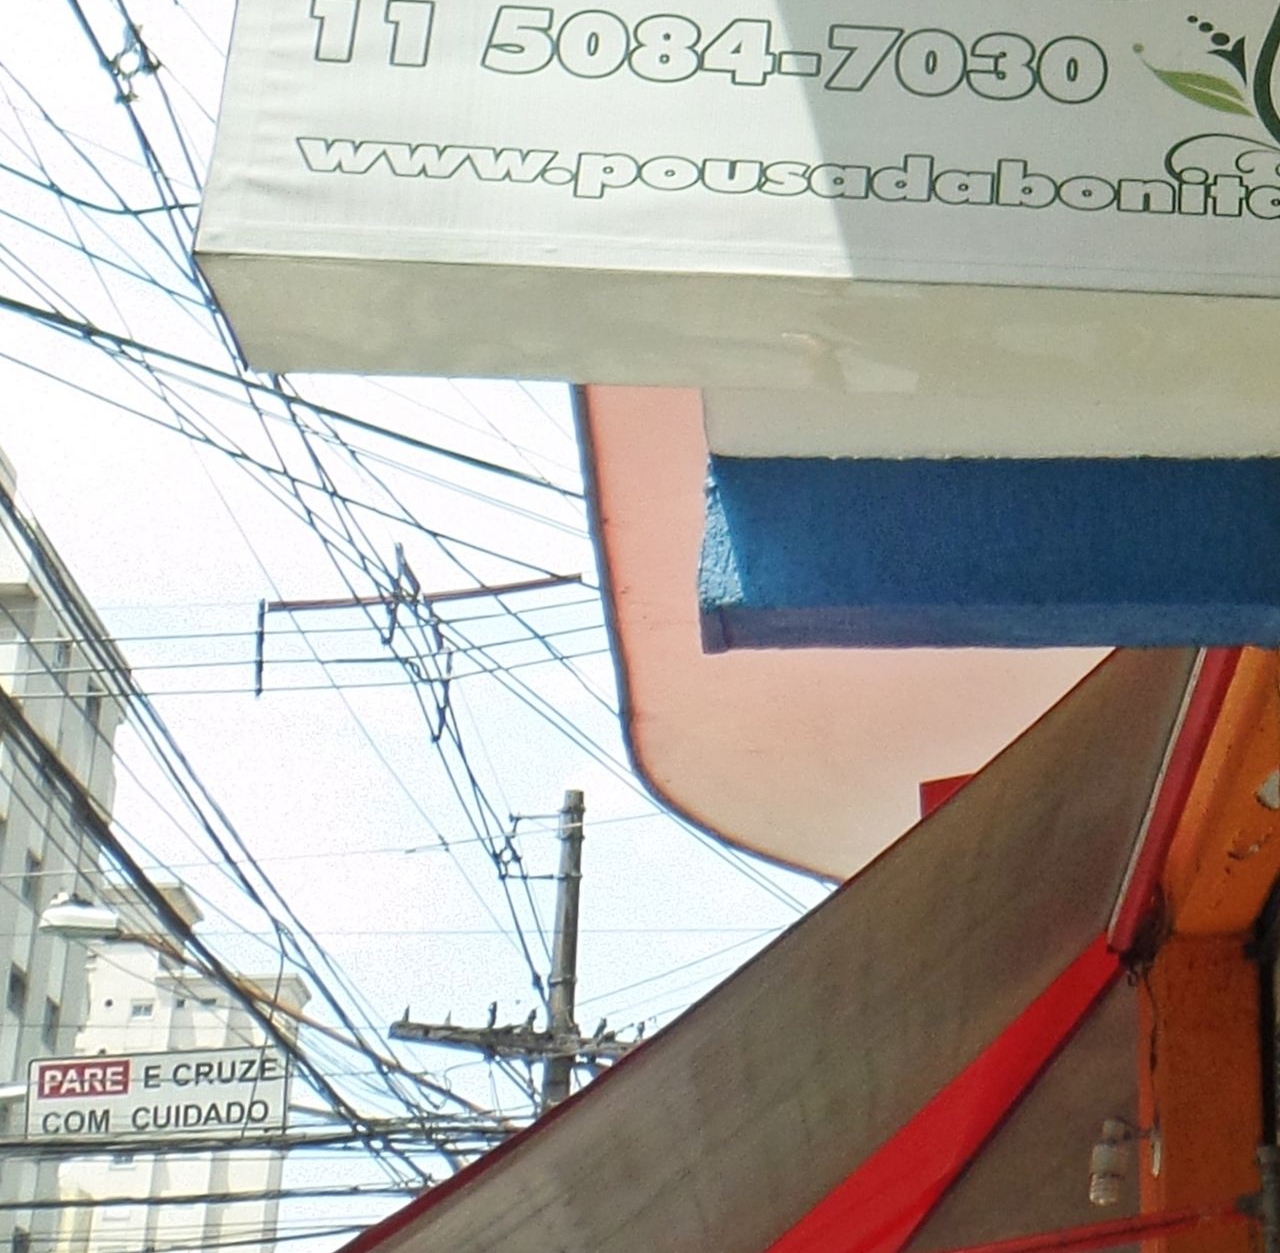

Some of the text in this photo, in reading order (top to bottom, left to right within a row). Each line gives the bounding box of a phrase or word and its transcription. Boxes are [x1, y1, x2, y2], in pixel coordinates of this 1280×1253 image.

[482, 6, 1108, 103] 5084-7030
[43, 1058, 279, 1095] PARE E CRUZE
[42, 1100, 269, 1135] COM CUIDADO
